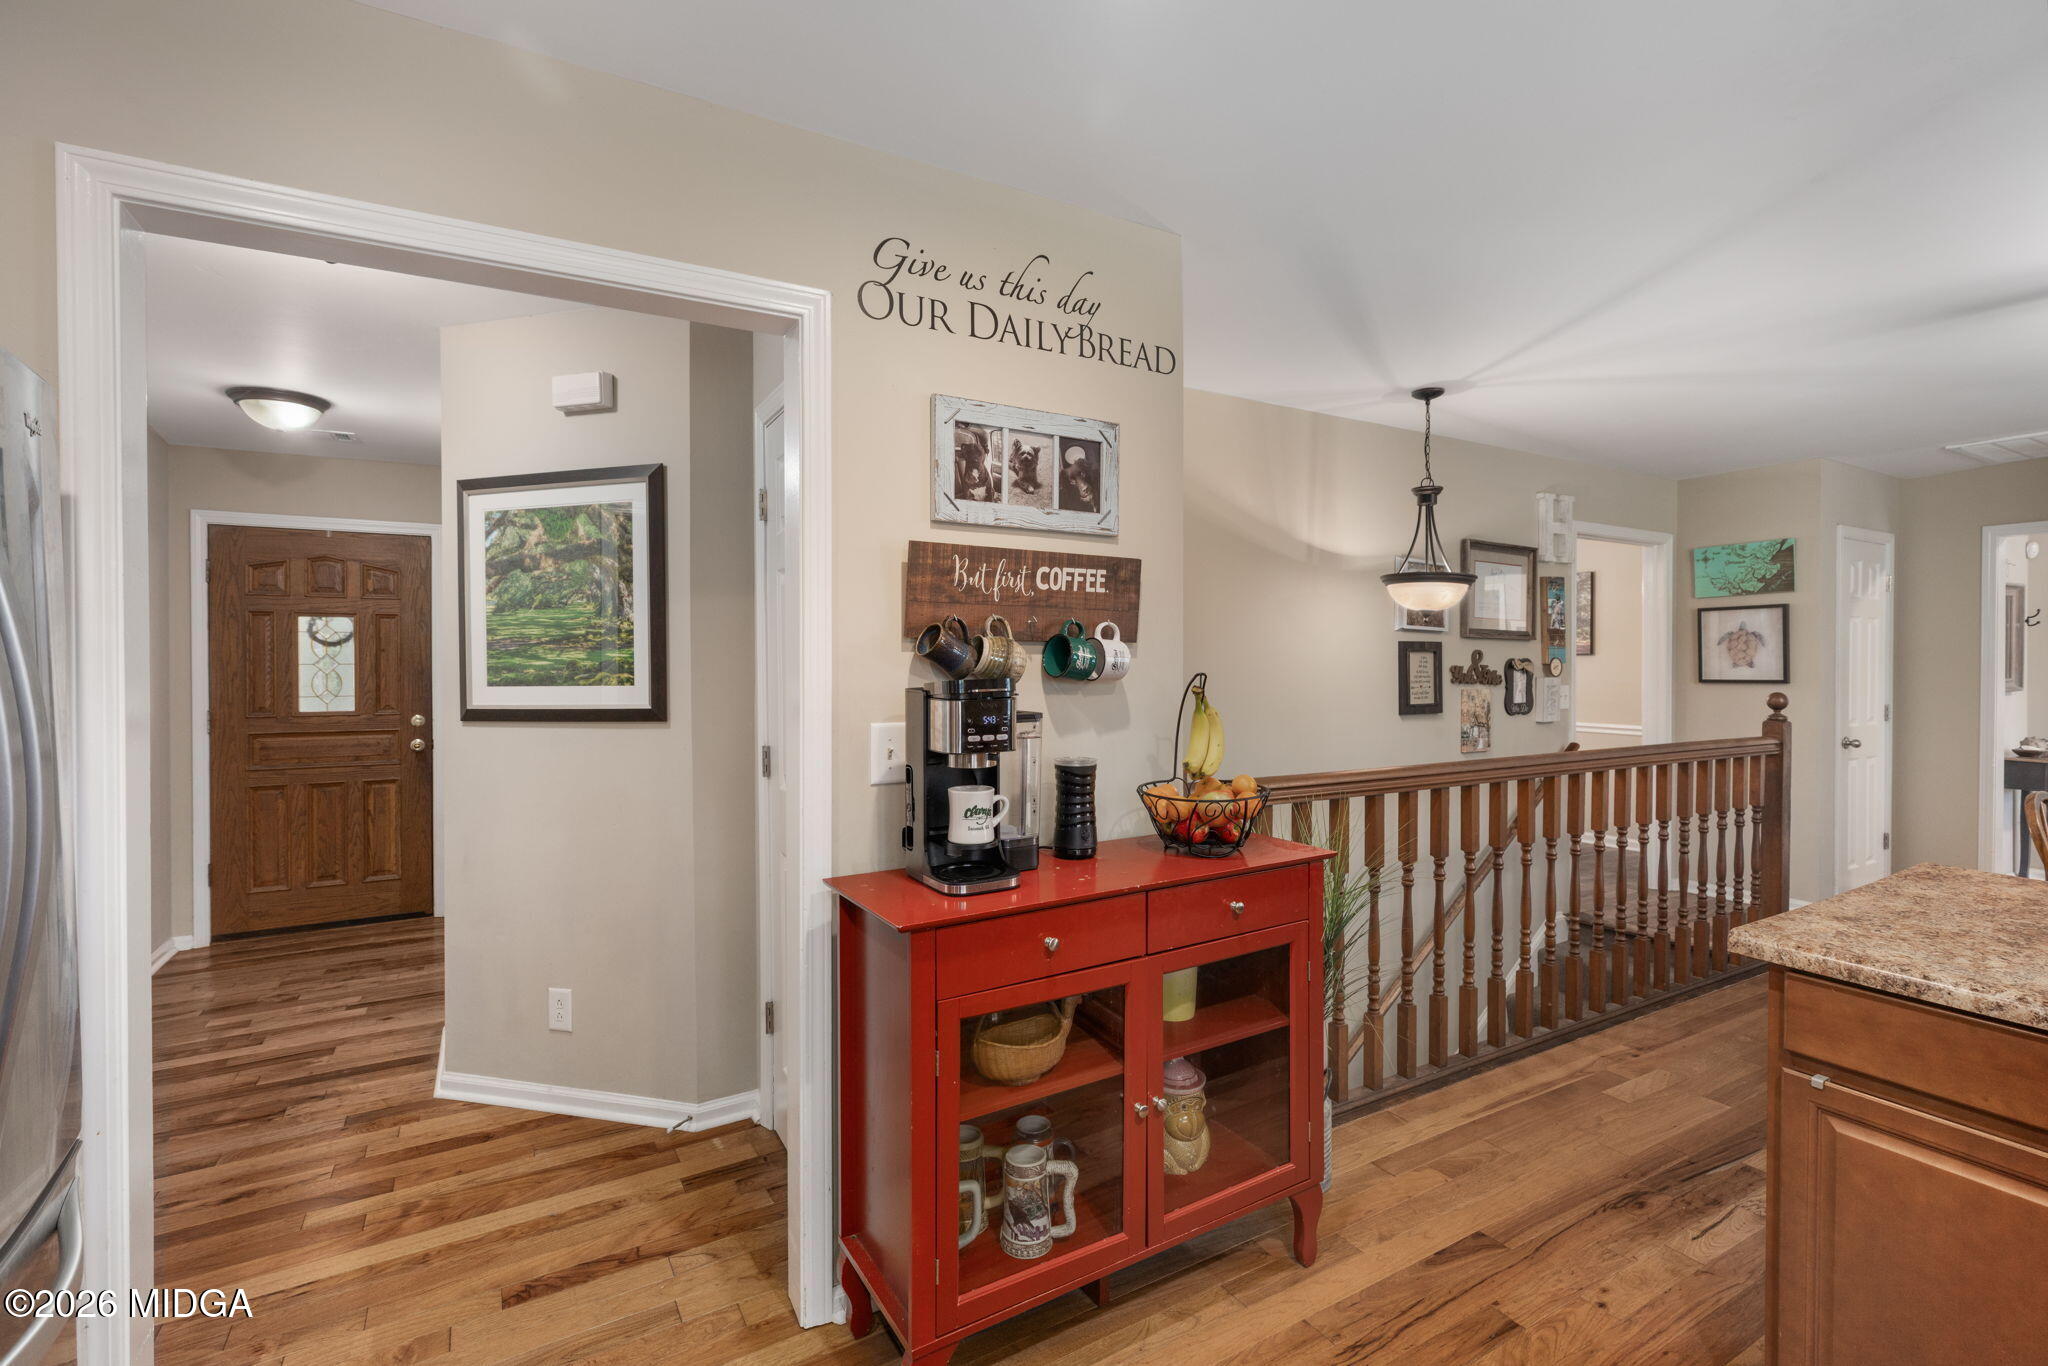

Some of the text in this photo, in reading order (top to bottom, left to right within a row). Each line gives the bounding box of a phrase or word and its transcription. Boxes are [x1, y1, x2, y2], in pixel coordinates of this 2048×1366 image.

[857, 280, 1176, 375] OUR DAILY BREAD
[873, 237, 1101, 339] Give us this day
[952, 554, 1108, 602] But first, COFFEE.
